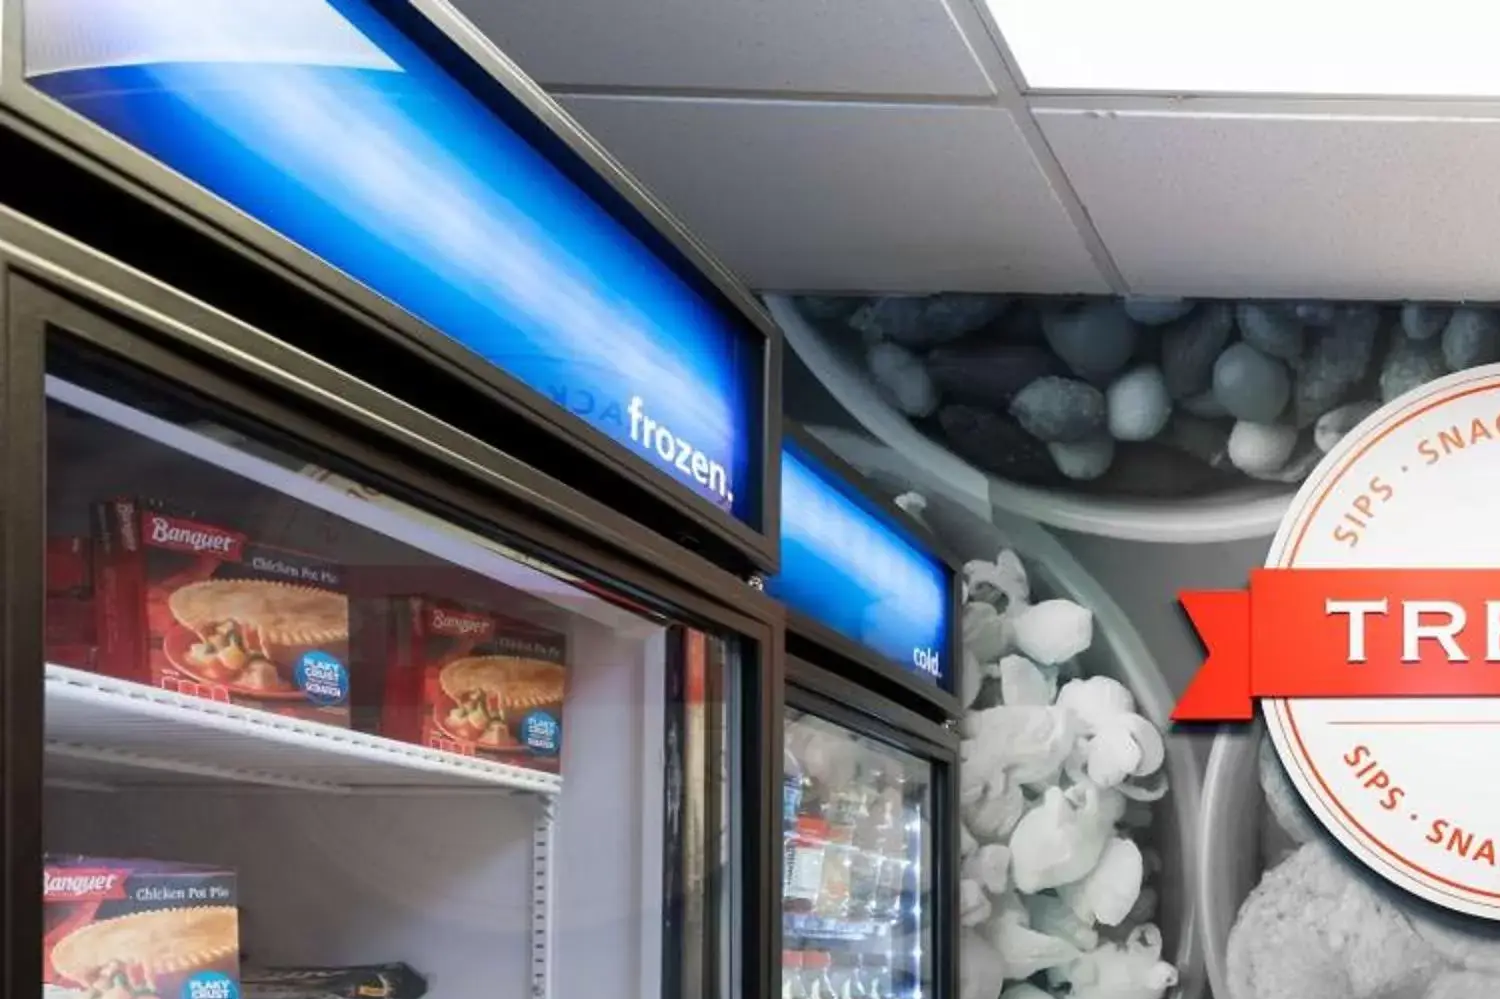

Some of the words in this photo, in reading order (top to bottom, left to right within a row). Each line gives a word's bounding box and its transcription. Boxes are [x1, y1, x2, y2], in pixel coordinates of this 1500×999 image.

[152, 516, 236, 552] Banquet
[1333, 475, 1394, 547] SIPS
[1343, 744, 1405, 811] SIPS
[136, 886, 186, 902] Chicken
[188, 887, 207, 900] Pot
